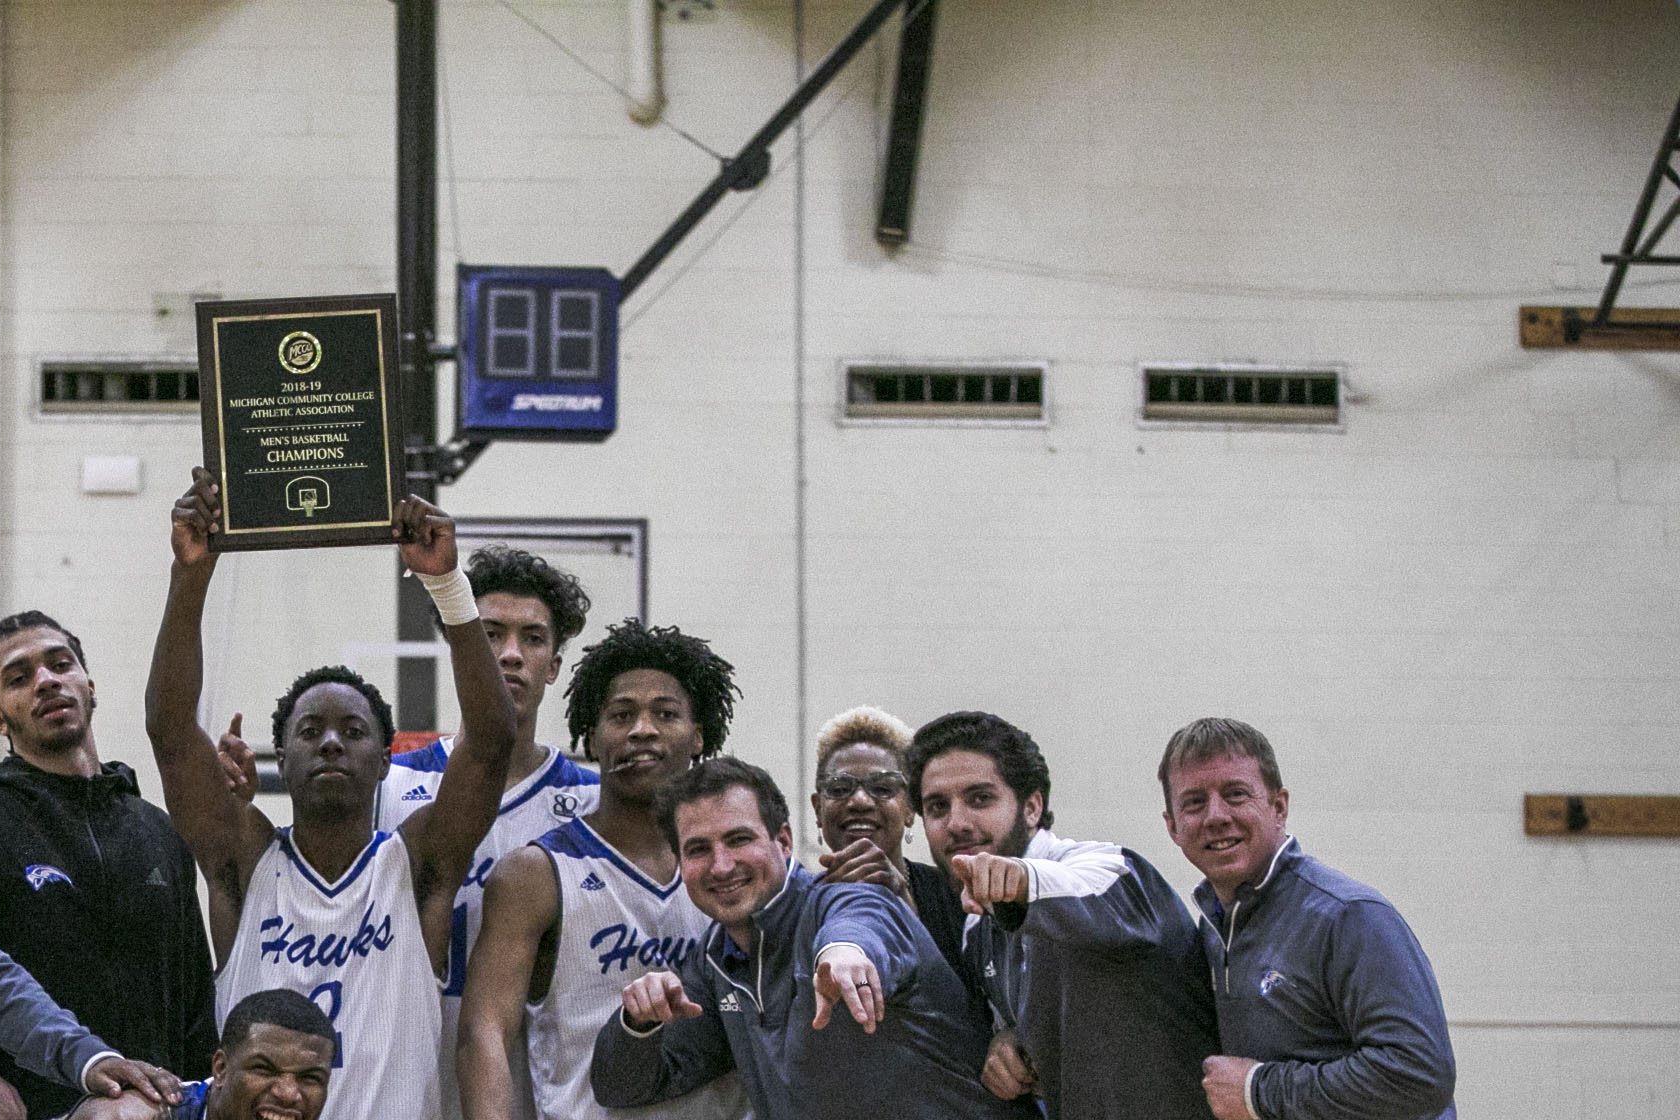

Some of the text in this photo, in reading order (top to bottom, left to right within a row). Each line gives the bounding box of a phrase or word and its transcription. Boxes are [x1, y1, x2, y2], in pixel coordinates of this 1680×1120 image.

[281, 381, 322, 393] 2018-19
[229, 391, 375, 408] MICHIGAN COMMUNITY COLLEGE
[251, 404, 355, 419] ATHLETIC ASSOCIATION
[260, 433, 350, 447] MEN'S BASKETBALL
[267, 447, 344, 463] CHAMPIONS
[260, 901, 394, 968] Hawks
[590, 923, 696, 974] Haw
